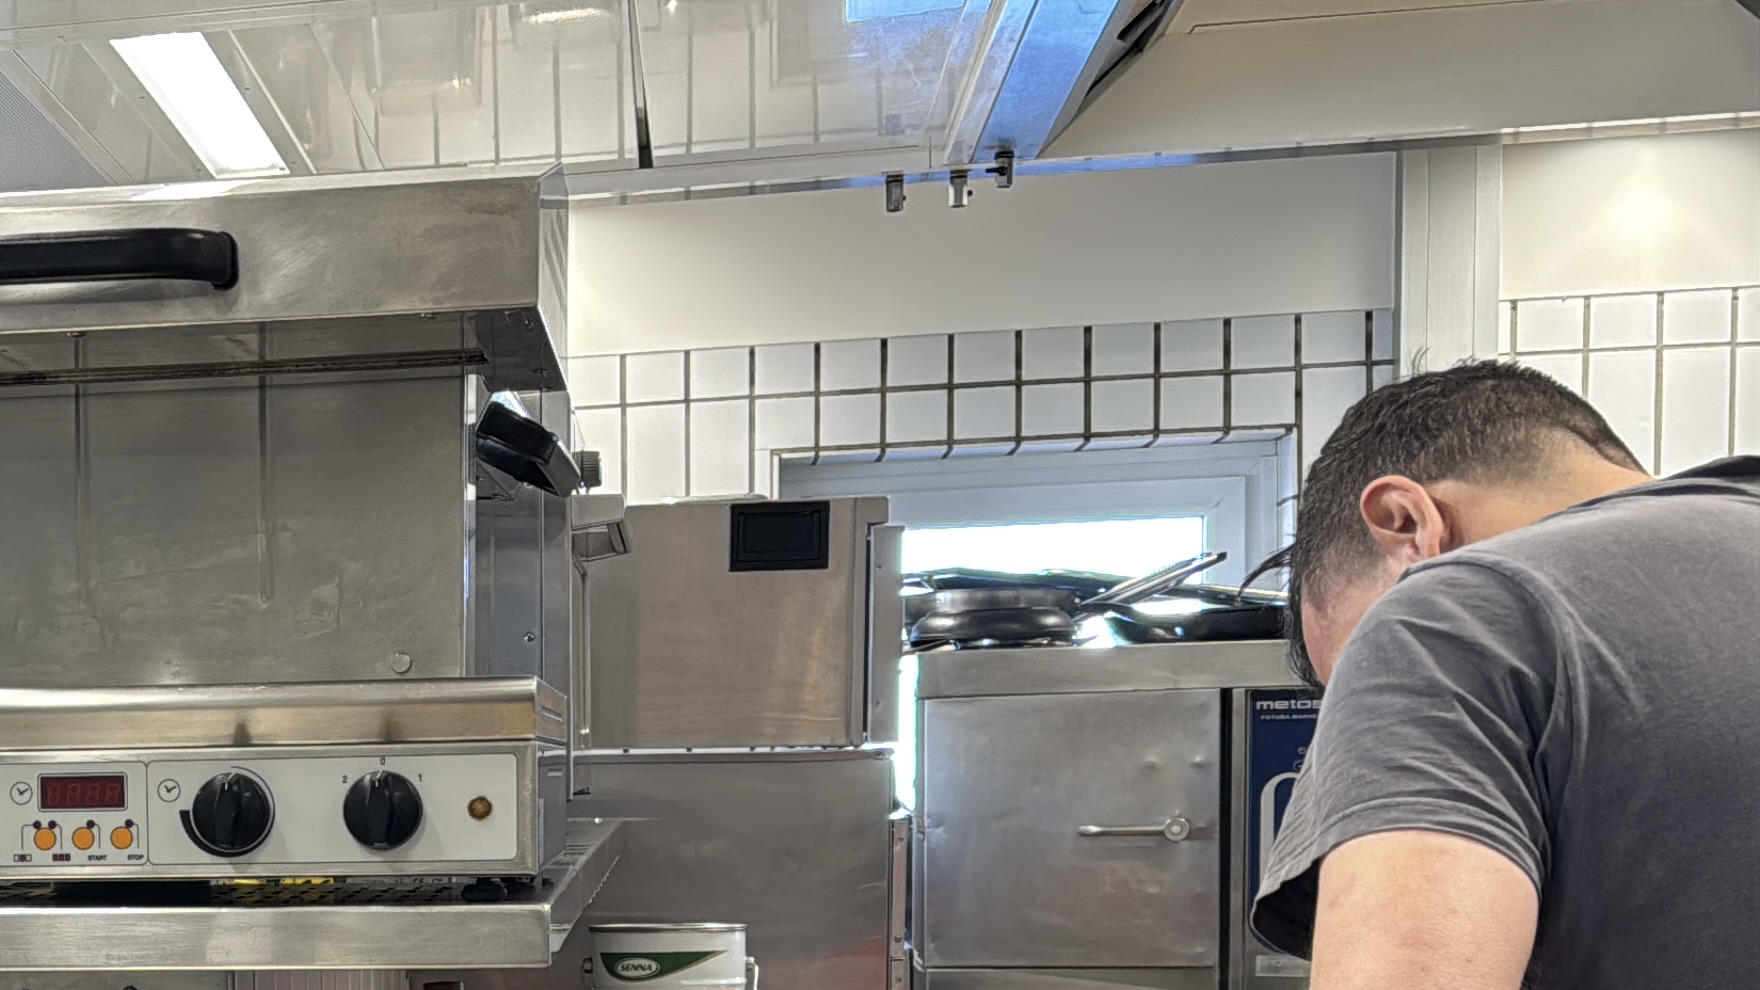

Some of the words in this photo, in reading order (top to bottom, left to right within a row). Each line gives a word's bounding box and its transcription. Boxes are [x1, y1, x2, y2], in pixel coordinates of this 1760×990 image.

[380, 757, 386, 766] 0
[342, 775, 348, 784] 2
[418, 774, 423, 782] 1
[619, 963, 653, 973] SENNA
